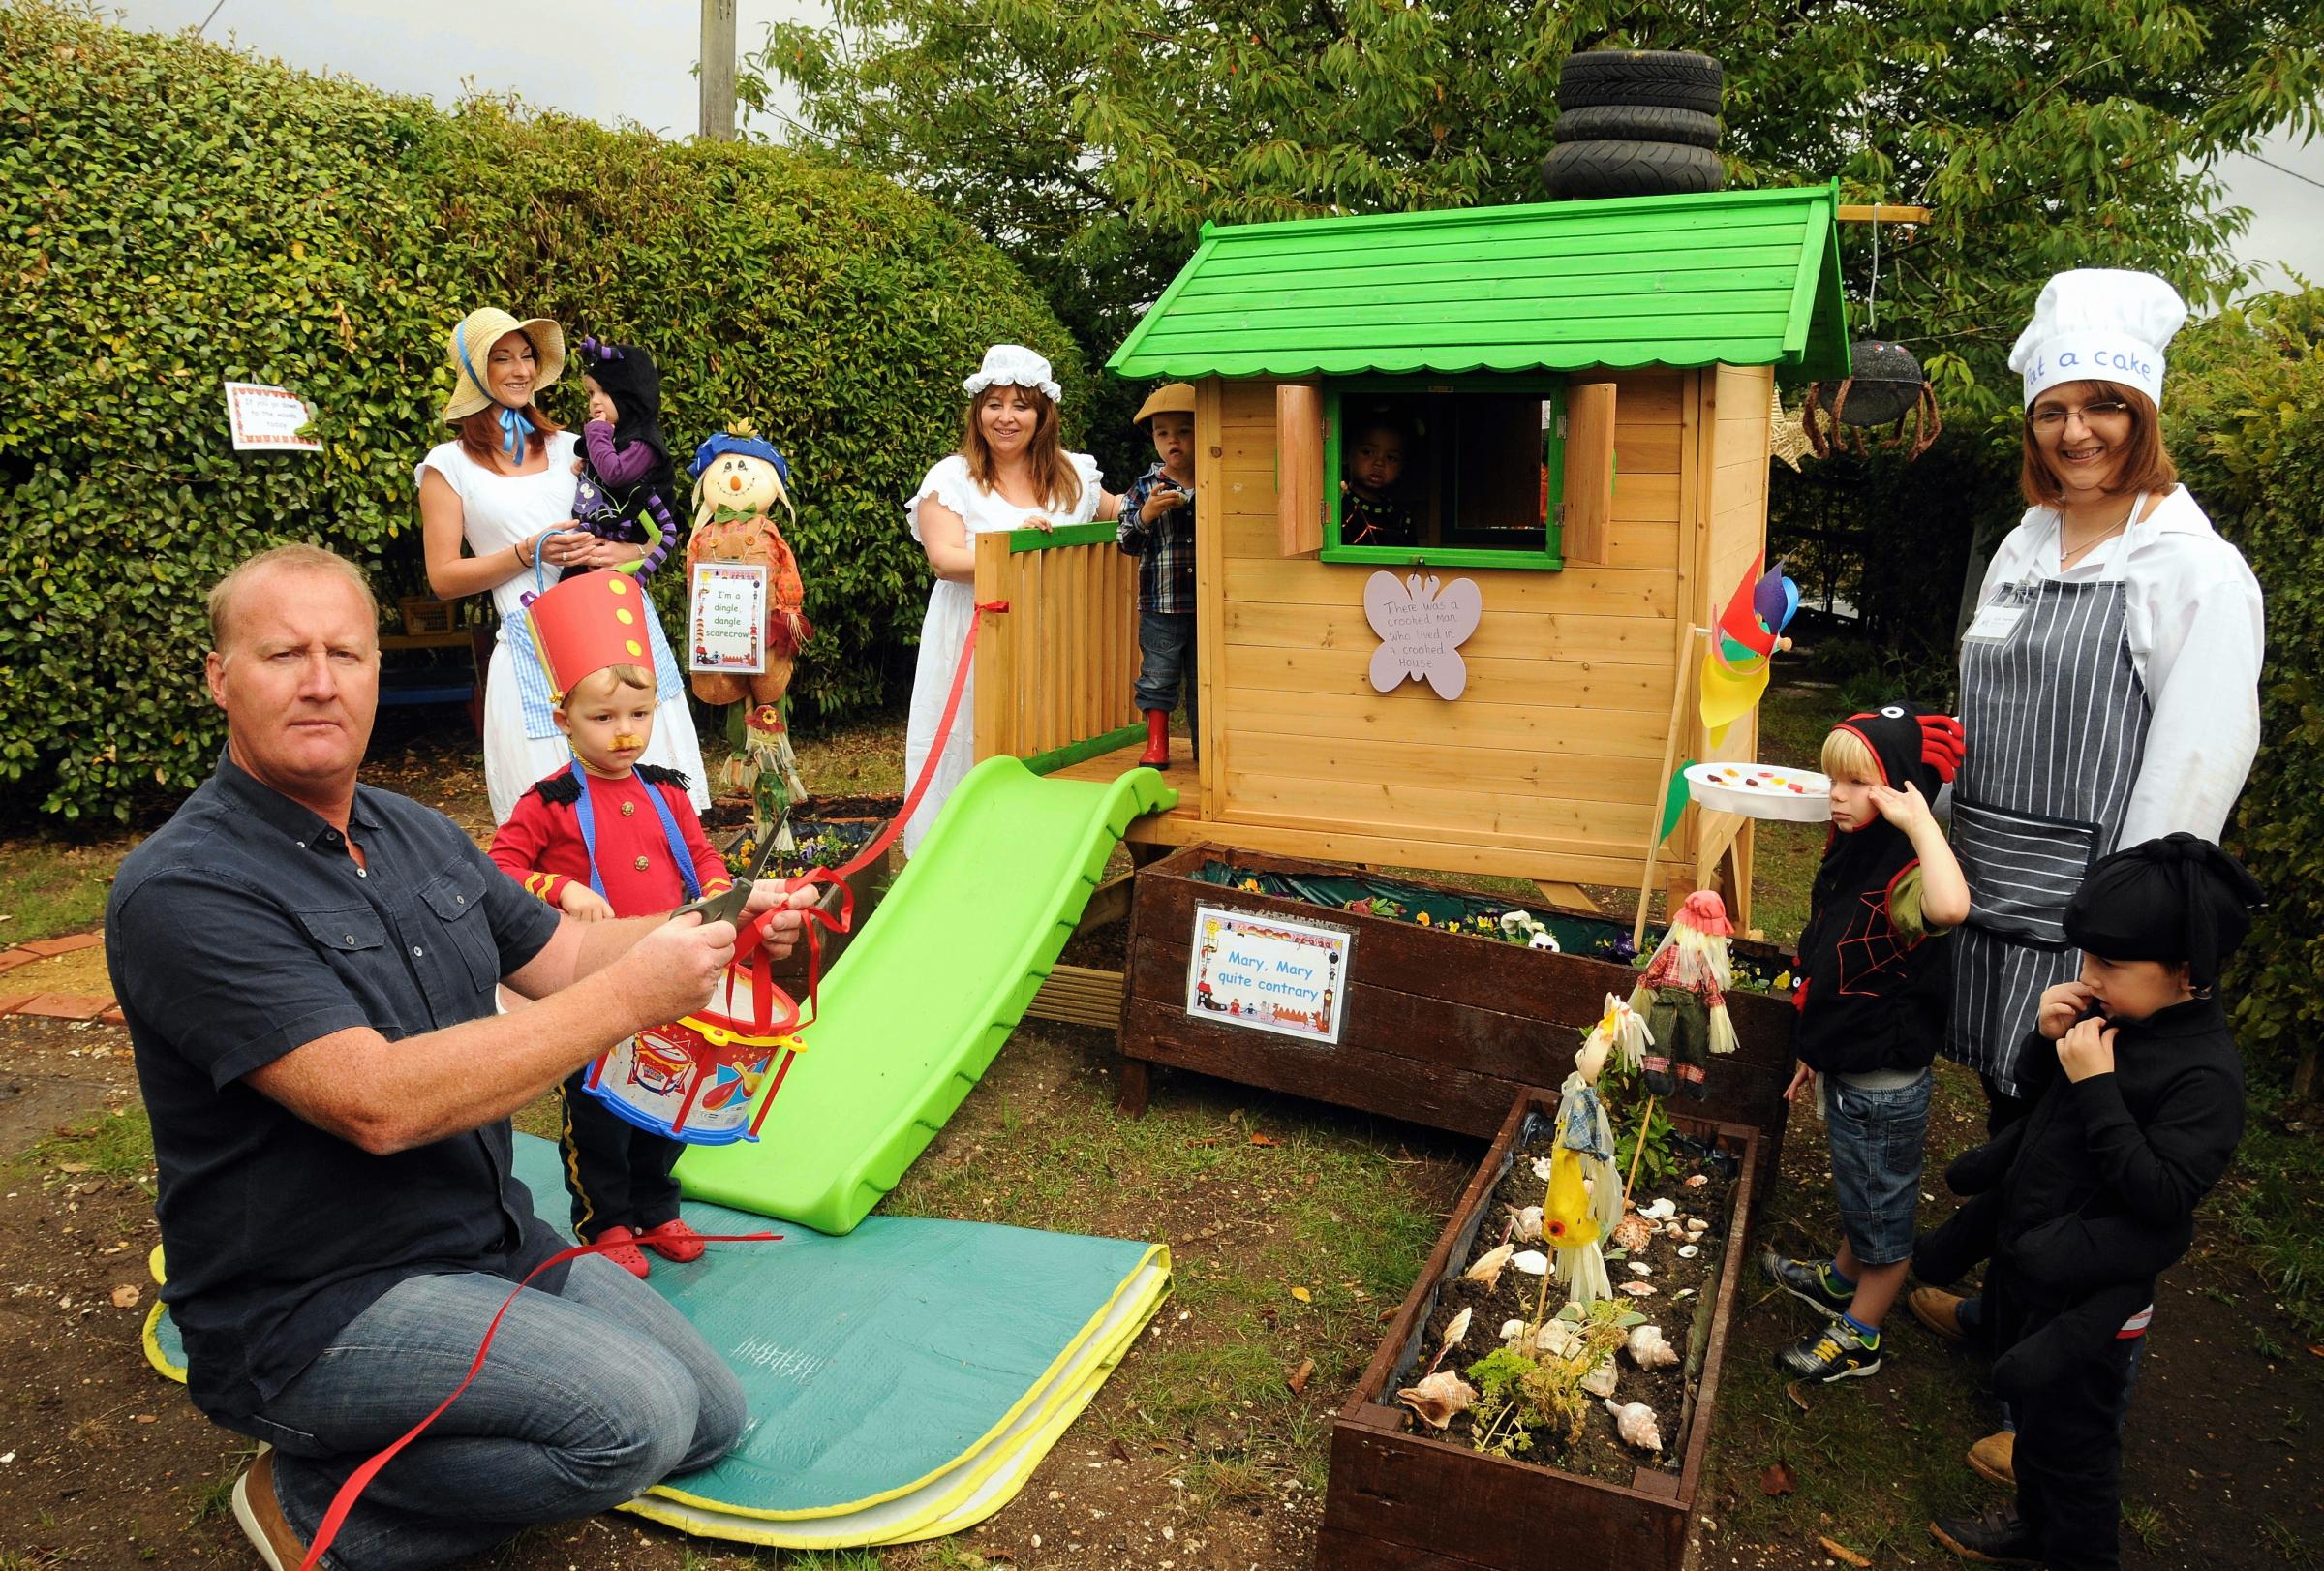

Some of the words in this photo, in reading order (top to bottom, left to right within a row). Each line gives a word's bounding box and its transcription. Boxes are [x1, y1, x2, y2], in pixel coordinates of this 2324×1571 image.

[2059, 352, 2080, 368] a
[2094, 351, 2151, 383] cake
[1383, 601, 1419, 614] There
[1422, 601, 1446, 610] was
[1451, 601, 1460, 610] a
[714, 617, 741, 627] dangle
[1416, 628, 1441, 639] lived
[1445, 631, 1455, 639] in
[1228, 951, 1268, 972] Mary,
[1276, 960, 1313, 980] Mary
[1218, 970, 1252, 987] quite
[1258, 980, 1319, 1002] contrary
